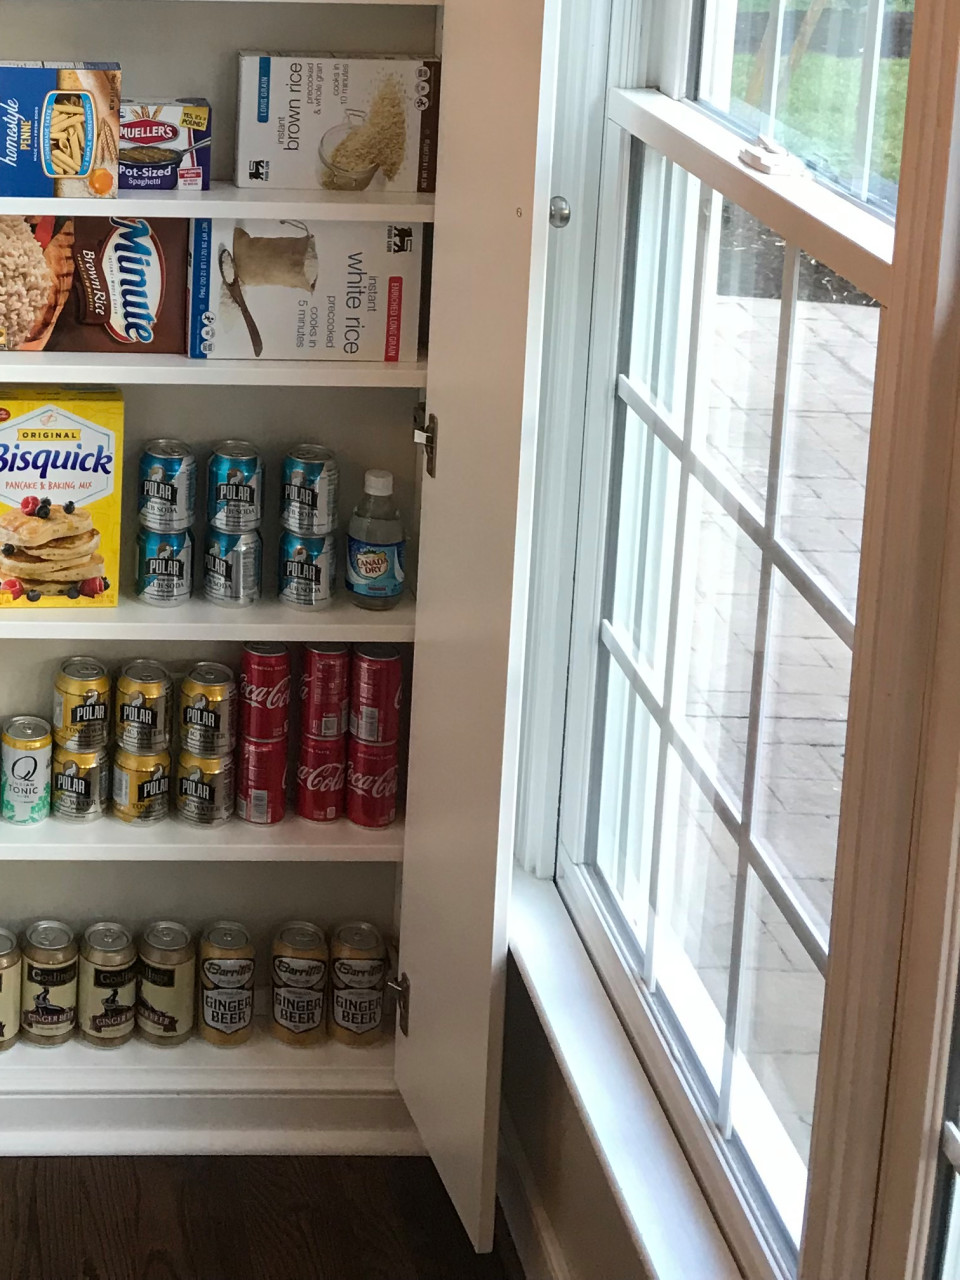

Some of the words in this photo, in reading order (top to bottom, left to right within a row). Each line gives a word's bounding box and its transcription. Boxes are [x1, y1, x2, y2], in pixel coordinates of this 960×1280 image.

[286, 62, 303, 94] rice
[315, 62, 324, 84] grain
[341, 63, 349, 94] minutes
[261, 76, 269, 99] GRAIN
[306, 62, 314, 104] precooked
[332, 71, 340, 96] cooks
[314, 86, 322, 107] whole
[340, 95, 347, 105] 10
[260, 99, 269, 116] LONG
[120, 124, 174, 139] MUELLER'S
[277, 117, 286, 145] instant
[283, 98, 301, 151] brown
[20, 120, 32, 151] PENNE
[119, 165, 172, 179] Pot-Sized
[128, 177, 161, 186] Spaghetti
[82, 249, 101, 291] Brown
[93, 290, 107, 316] Rice
[111, 217, 154, 343] Minute
[346, 252, 369, 310] white
[366, 275, 379, 313] instant
[390, 282, 400, 316] ENRICHED
[298, 300, 308, 308] 5
[296, 308, 307, 348] minutes
[309, 306, 319, 332] cooks
[326, 295, 336, 349] precooked
[389, 316, 399, 335] LONG
[308, 333, 317, 348] in
[343, 317, 365, 355] rice
[387, 336, 397, 357] GRAIN
[21, 431, 78, 439] ORIGINAL
[5, 480, 38, 490] PANCAKE
[39, 480, 46, 490] &
[48, 480, 76, 491] BAKING
[78, 480, 93, 490] MIX
[143, 480, 172, 500] POLAR
[220, 485, 250, 502] POLAR
[284, 485, 312, 505] POLAR
[156, 506, 178, 514] SODA
[235, 507, 256, 515] SODA
[149, 559, 179, 576] POLAR
[286, 563, 316, 581] POLAR
[358, 558, 386, 568] CANADA
[364, 565, 382, 574] DRY
[76, 705, 105, 721] POLAR
[123, 706, 152, 725] POLAR
[186, 708, 215, 727] POLAR
[11, 755, 39, 782] Q
[8, 783, 39, 795] TONIC
[57, 775, 85, 795] POLAR
[182, 779, 210, 799] POLAR
[205, 995, 251, 1012] GINGER
[275, 992, 321, 1012] GINGER
[335, 995, 380, 1012] GINGER
[28, 1013, 58, 1023] GINGER
[96, 1013, 126, 1026] GINGER
[211, 1010, 246, 1024] BEER
[280, 1010, 316, 1024] BEER
[341, 1010, 376, 1025] BEER
